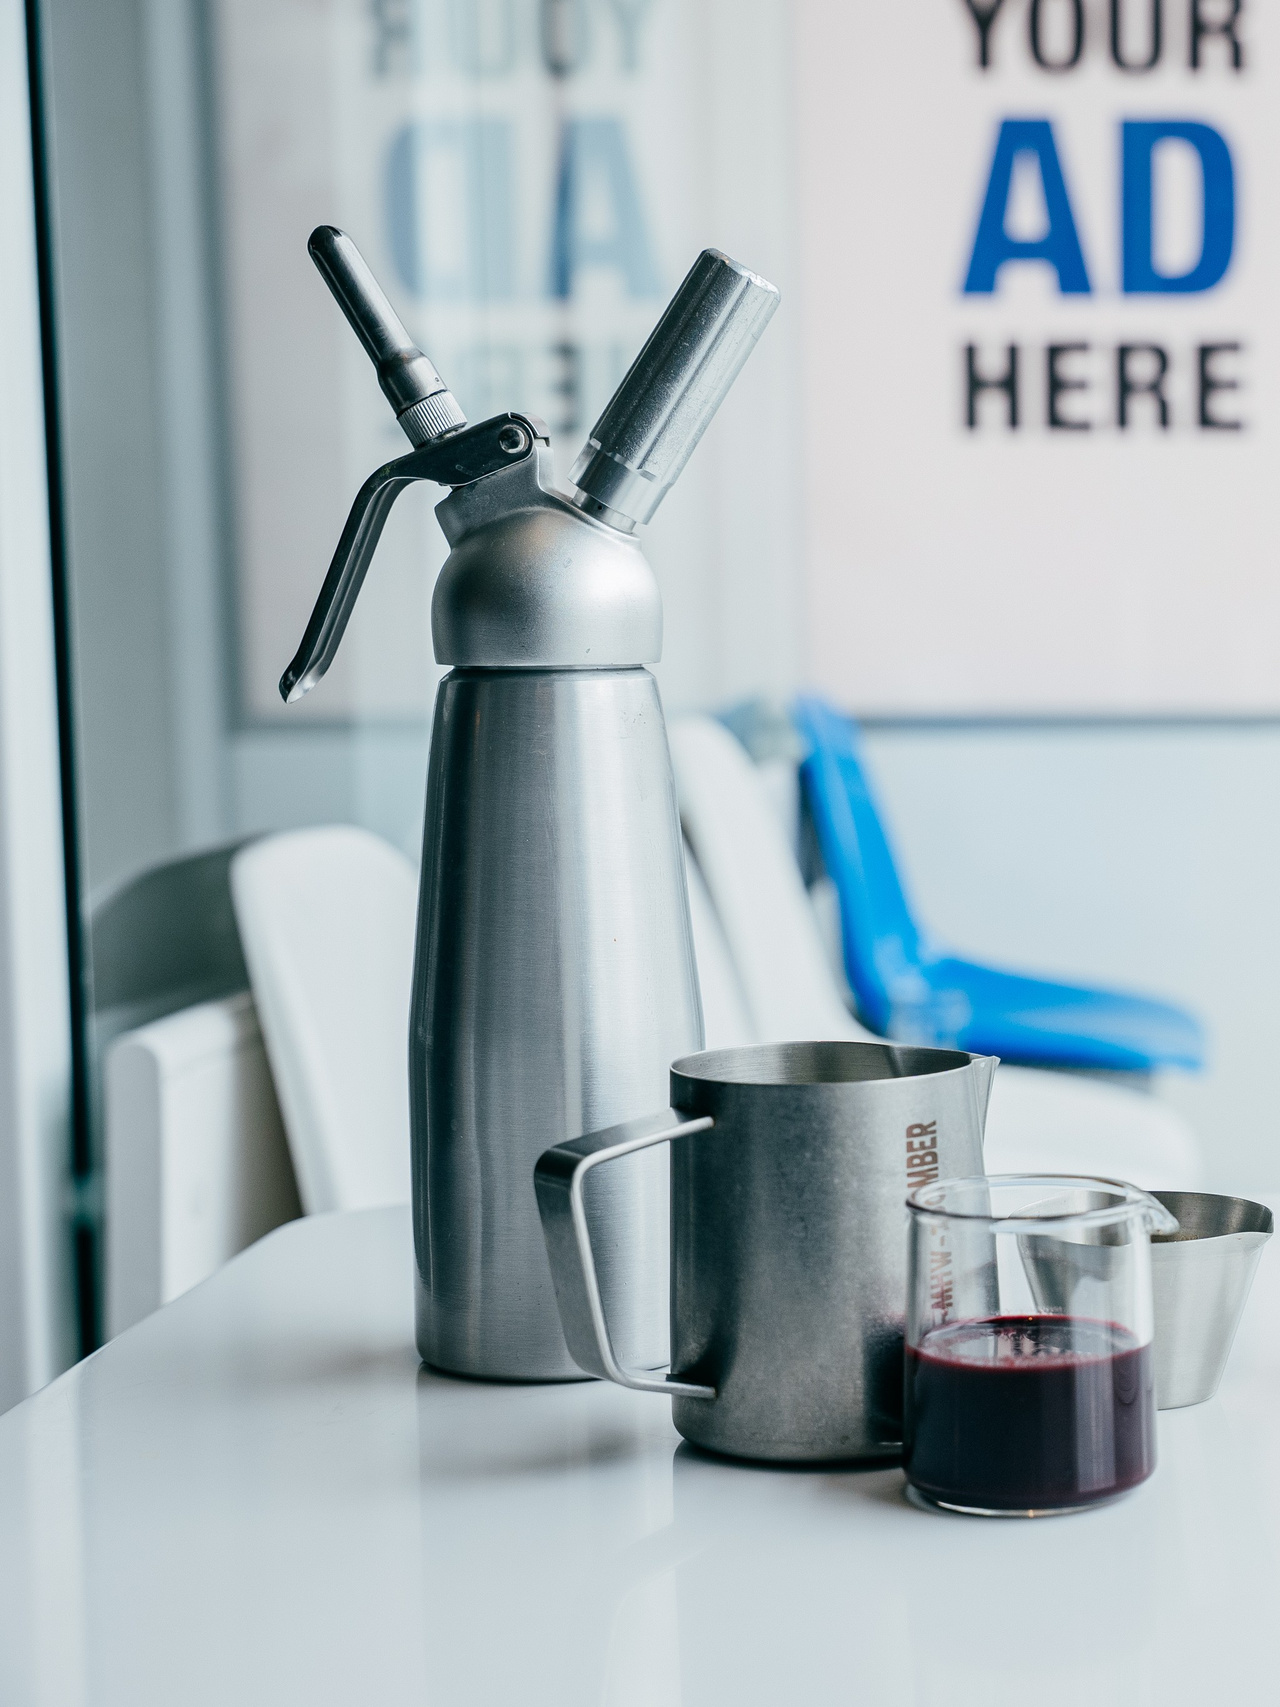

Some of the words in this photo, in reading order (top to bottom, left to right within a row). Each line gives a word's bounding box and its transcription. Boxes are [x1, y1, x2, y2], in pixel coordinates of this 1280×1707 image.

[956, 0, 1248, 75] YOUR
[960, 117, 1238, 297] AD
[961, 340, 1246, 433] HERE
